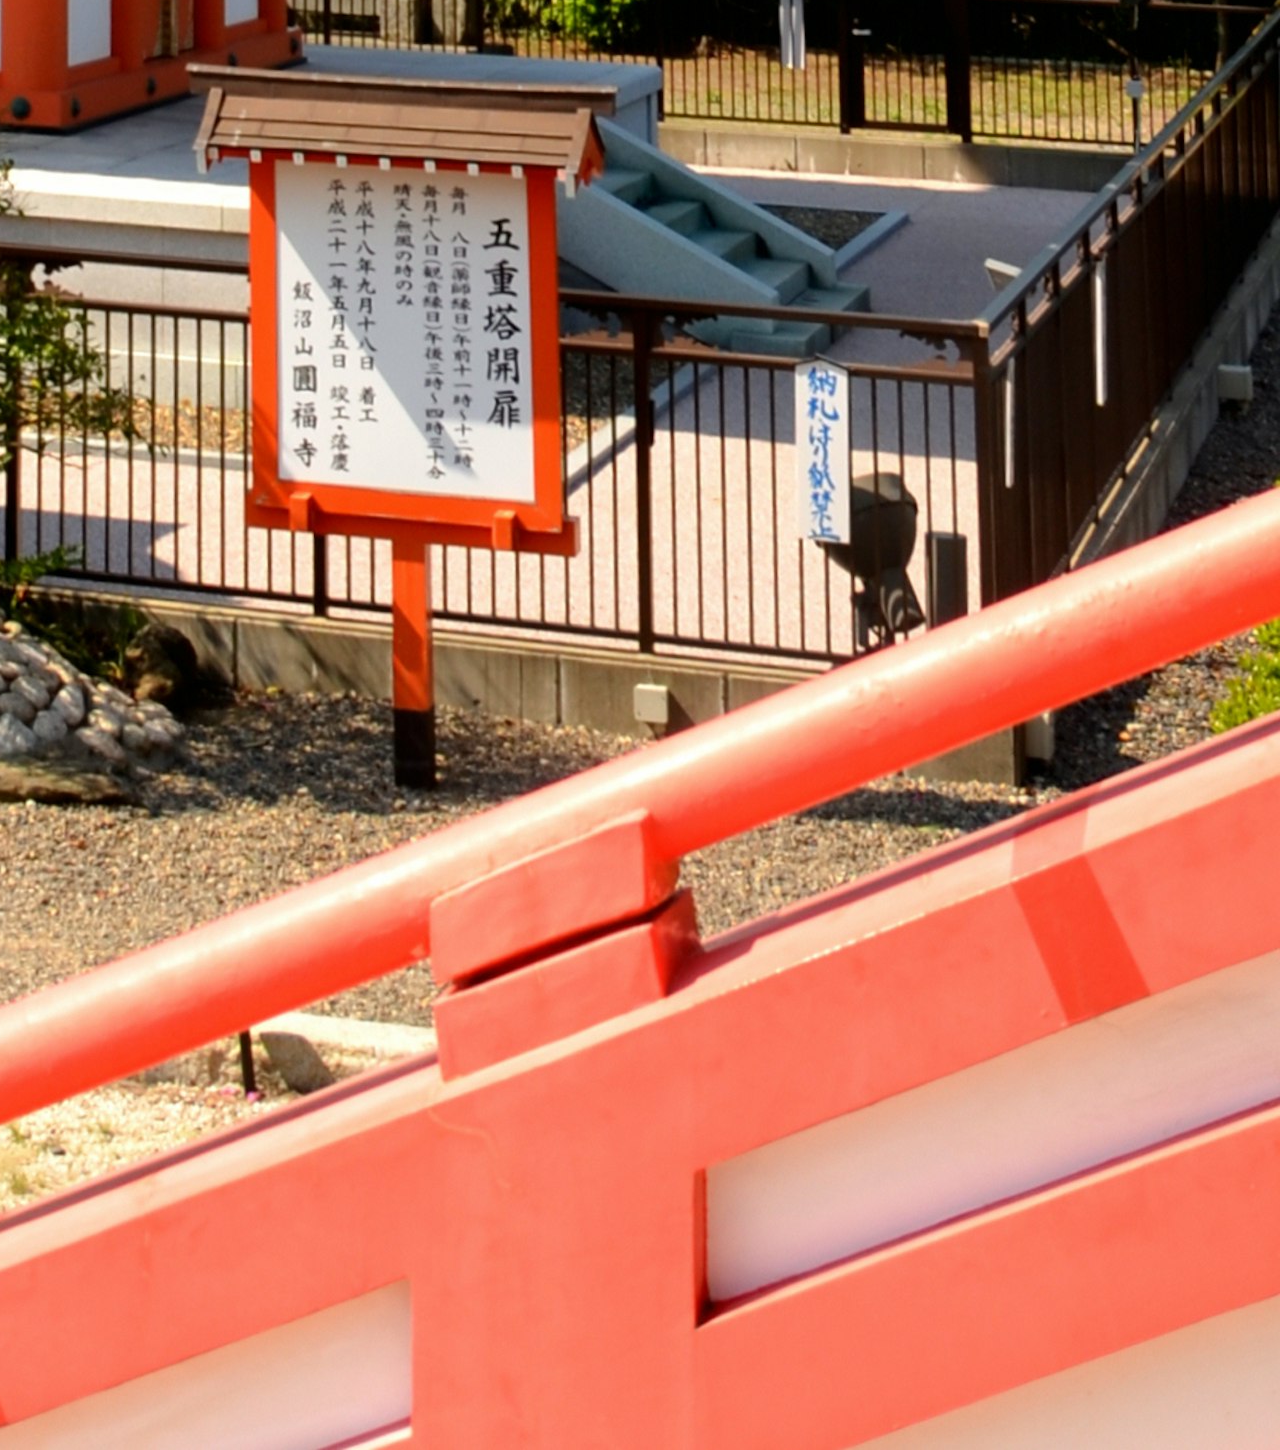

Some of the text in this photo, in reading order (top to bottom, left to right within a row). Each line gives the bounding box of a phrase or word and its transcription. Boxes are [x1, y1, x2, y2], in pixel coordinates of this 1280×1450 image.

[327, 179, 348, 370] 平成二十一年五月五日
[355, 180, 378, 423] 平成十八年九月十八日 着工
[483, 218, 522, 429] 五重塔開扉
